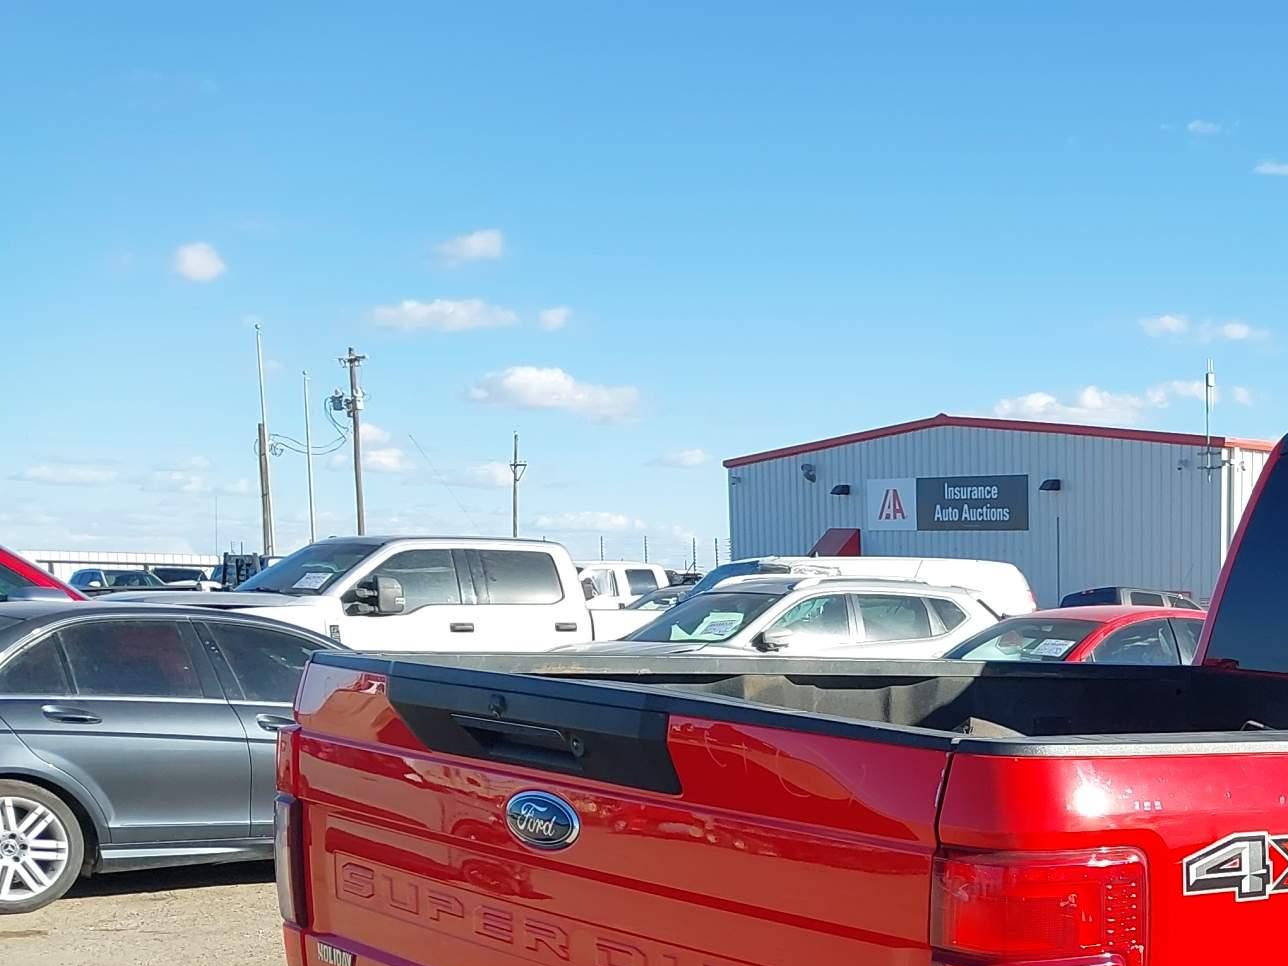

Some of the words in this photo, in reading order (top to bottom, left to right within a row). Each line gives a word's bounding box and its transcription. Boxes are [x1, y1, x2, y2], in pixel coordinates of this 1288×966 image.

[944, 483, 998, 499] Insurance
[934, 504, 959, 521] Auto
[961, 503, 1010, 521] Auctions
[341, 861, 571, 962] SUPER
